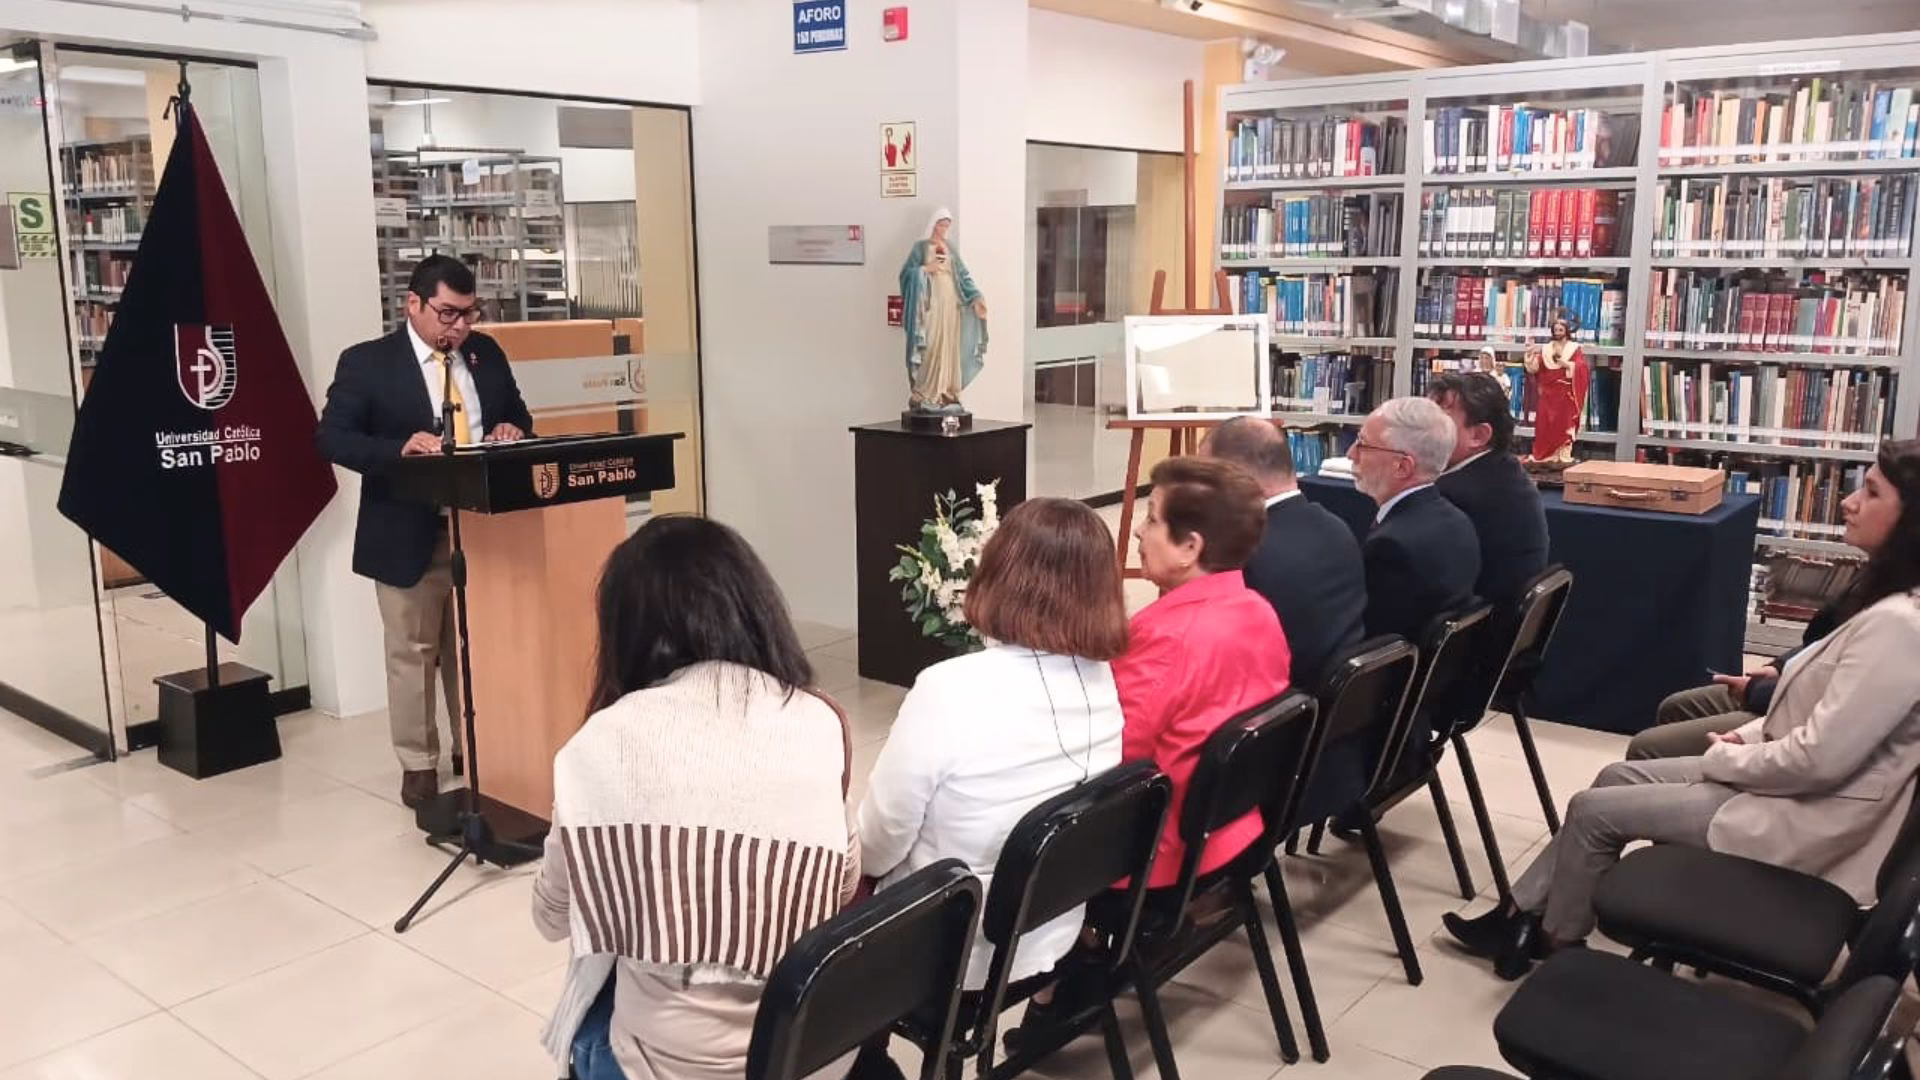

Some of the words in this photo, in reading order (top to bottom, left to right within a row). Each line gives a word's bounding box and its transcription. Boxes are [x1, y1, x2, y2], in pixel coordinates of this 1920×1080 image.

[798, 5, 841, 24] AFORO
[20, 197, 44, 229] S
[155, 427, 220, 445] Universidad
[160, 448, 203, 469] San
[210, 442, 261, 465] Pablo
[567, 473, 595, 487] San
[598, 468, 636, 484] Pablo
